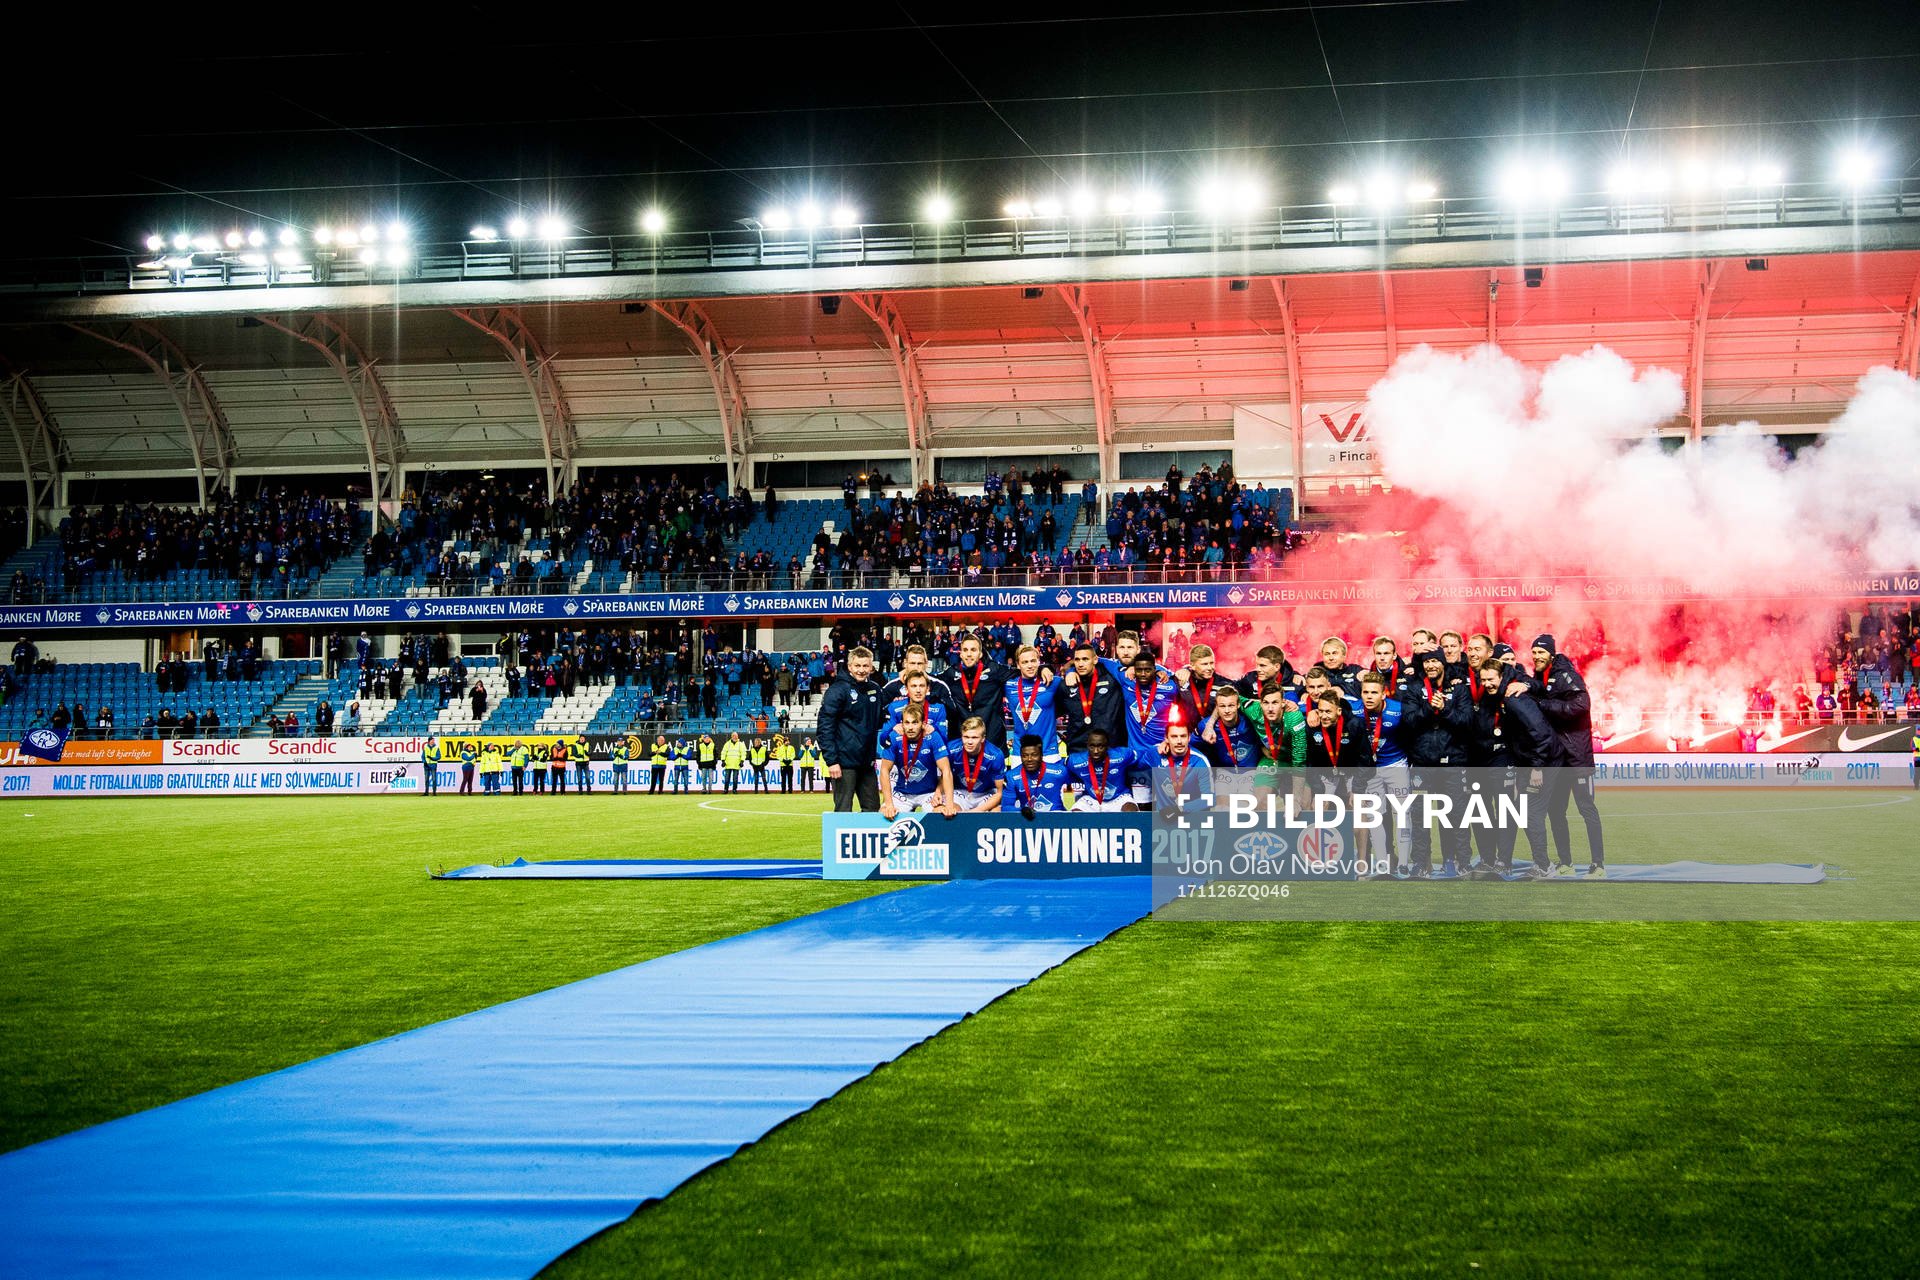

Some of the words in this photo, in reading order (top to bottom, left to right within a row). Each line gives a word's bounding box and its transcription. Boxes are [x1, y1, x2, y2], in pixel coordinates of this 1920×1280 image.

[1329, 453, 1336, 462] a
[1077, 591, 1164, 604] SPAREBANKEN
[1168, 589, 1207, 603] MØRE
[1249, 588, 1338, 601] SPAREBANKEN
[1425, 584, 1517, 599] SPAREBANKEN
[1521, 583, 1561, 597] MØRE
[583, 599, 665, 613] SPAREBANKEN
[669, 598, 705, 611] MØRE
[744, 596, 828, 610] SPAREBANKEN
[832, 594, 868, 609] MØRE
[909, 594, 994, 607] SPAREBANKEN
[998, 592, 1036, 606] MØRE
[46, 609, 82, 622] MØRE
[115, 608, 193, 621] SPAREBANKEN
[197, 607, 231, 620] MØRE
[266, 604, 349, 618] SPAREBANKEN
[353, 603, 390, 617] MØRE
[425, 602, 504, 616] SPAREBANKEN
[509, 601, 544, 614] MØRE
[173, 739, 240, 755] Scandic
[268, 738, 336, 754] Scandic
[75, 750, 90, 758] med
[92, 749, 105, 760] luft
[106, 749, 115, 758] &
[116, 748, 152, 760] kjærlighet
[1613, 763, 1640, 779] ALLE
[1645, 763, 1670, 779] MED
[1674, 760, 1756, 781] SØLVMEDALJE
[1776, 762, 1803, 775] ELITE
[1802, 770, 1833, 780] SERIEN
[1846, 762, 1880, 779] 2017!
[3, 775, 30, 791] 2017!
[53, 774, 87, 790] MOLDE
[90, 773, 163, 790] FOTBALLKLUBB
[167, 772, 229, 789] GRATULERER
[233, 772, 257, 788] ALLE
[261, 772, 281, 788] MED
[285, 771, 354, 789] SØLVMEDALJE
[370, 771, 393, 784] ELITE
[391, 777, 417, 788] SERIEN
[840, 833, 889, 858] ELITE
[976, 827, 1142, 864] SØLVVINNER
[1152, 828, 1215, 864] 2017
[887, 848, 945, 870] SERIEN
